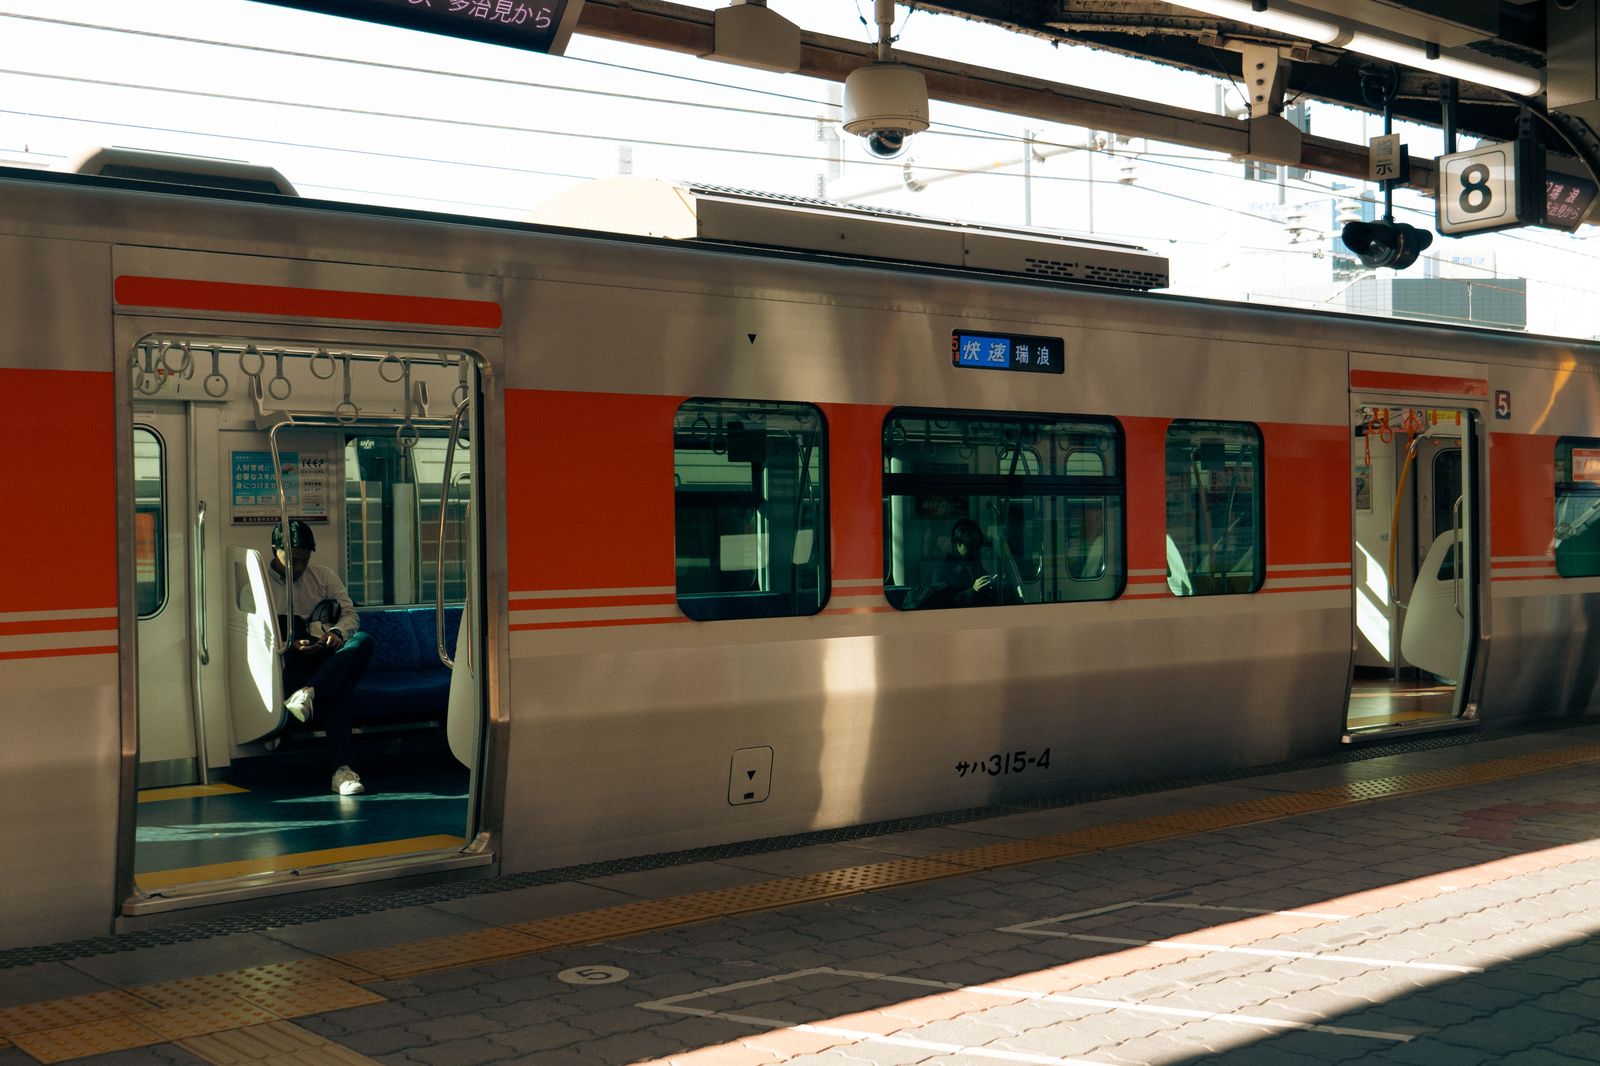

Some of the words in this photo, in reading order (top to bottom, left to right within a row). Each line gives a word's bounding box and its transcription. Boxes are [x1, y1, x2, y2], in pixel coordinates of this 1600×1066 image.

[1459, 163, 1492, 214] 8
[963, 340, 1007, 362] 快速
[1015, 344, 1050, 366] 瑞浪
[1498, 393, 1508, 416] 5
[955, 747, 1051, 778] サハ315-4
[575, 968, 613, 981] 5
